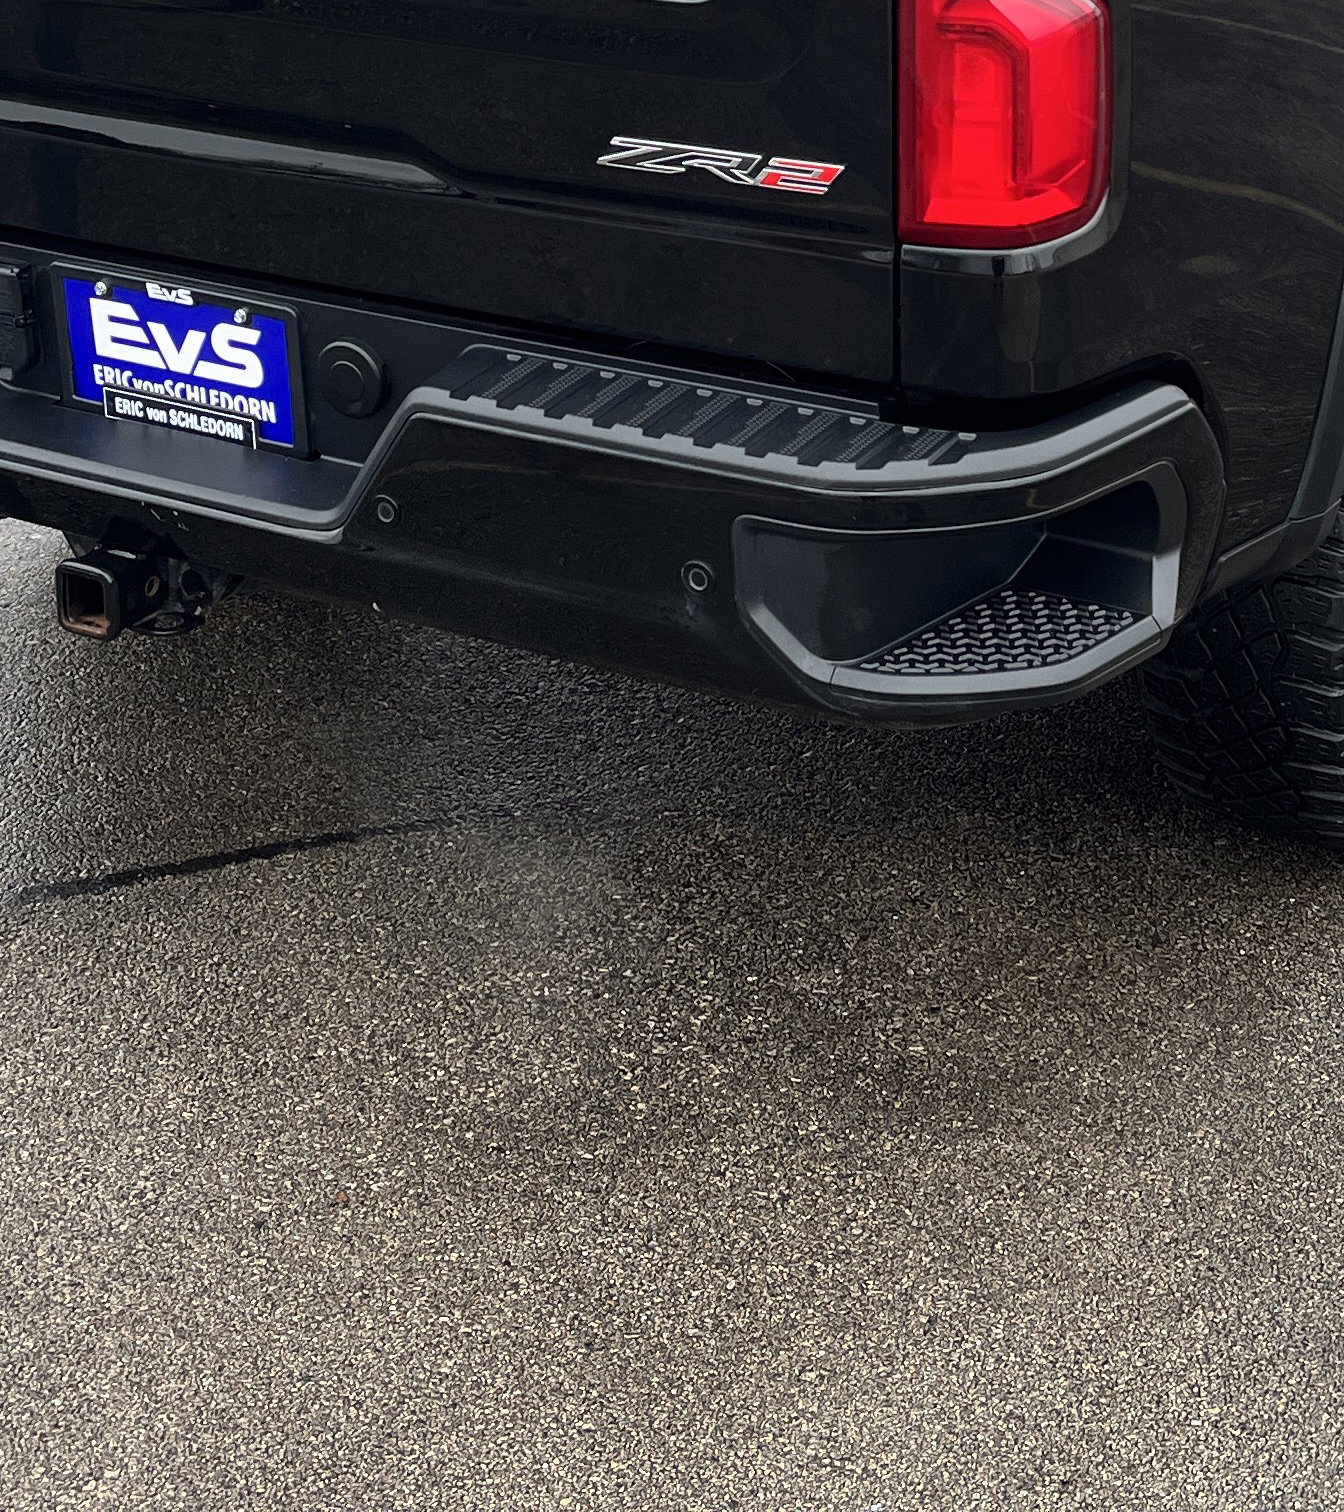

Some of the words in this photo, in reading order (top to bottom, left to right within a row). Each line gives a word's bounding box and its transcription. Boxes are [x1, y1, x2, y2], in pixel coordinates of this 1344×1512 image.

[596, 136, 846, 195] ZR2
[114, 397, 144, 418] ERIC
[146, 407, 167, 424] von
[169, 408, 244, 441] SCHLEDORN
